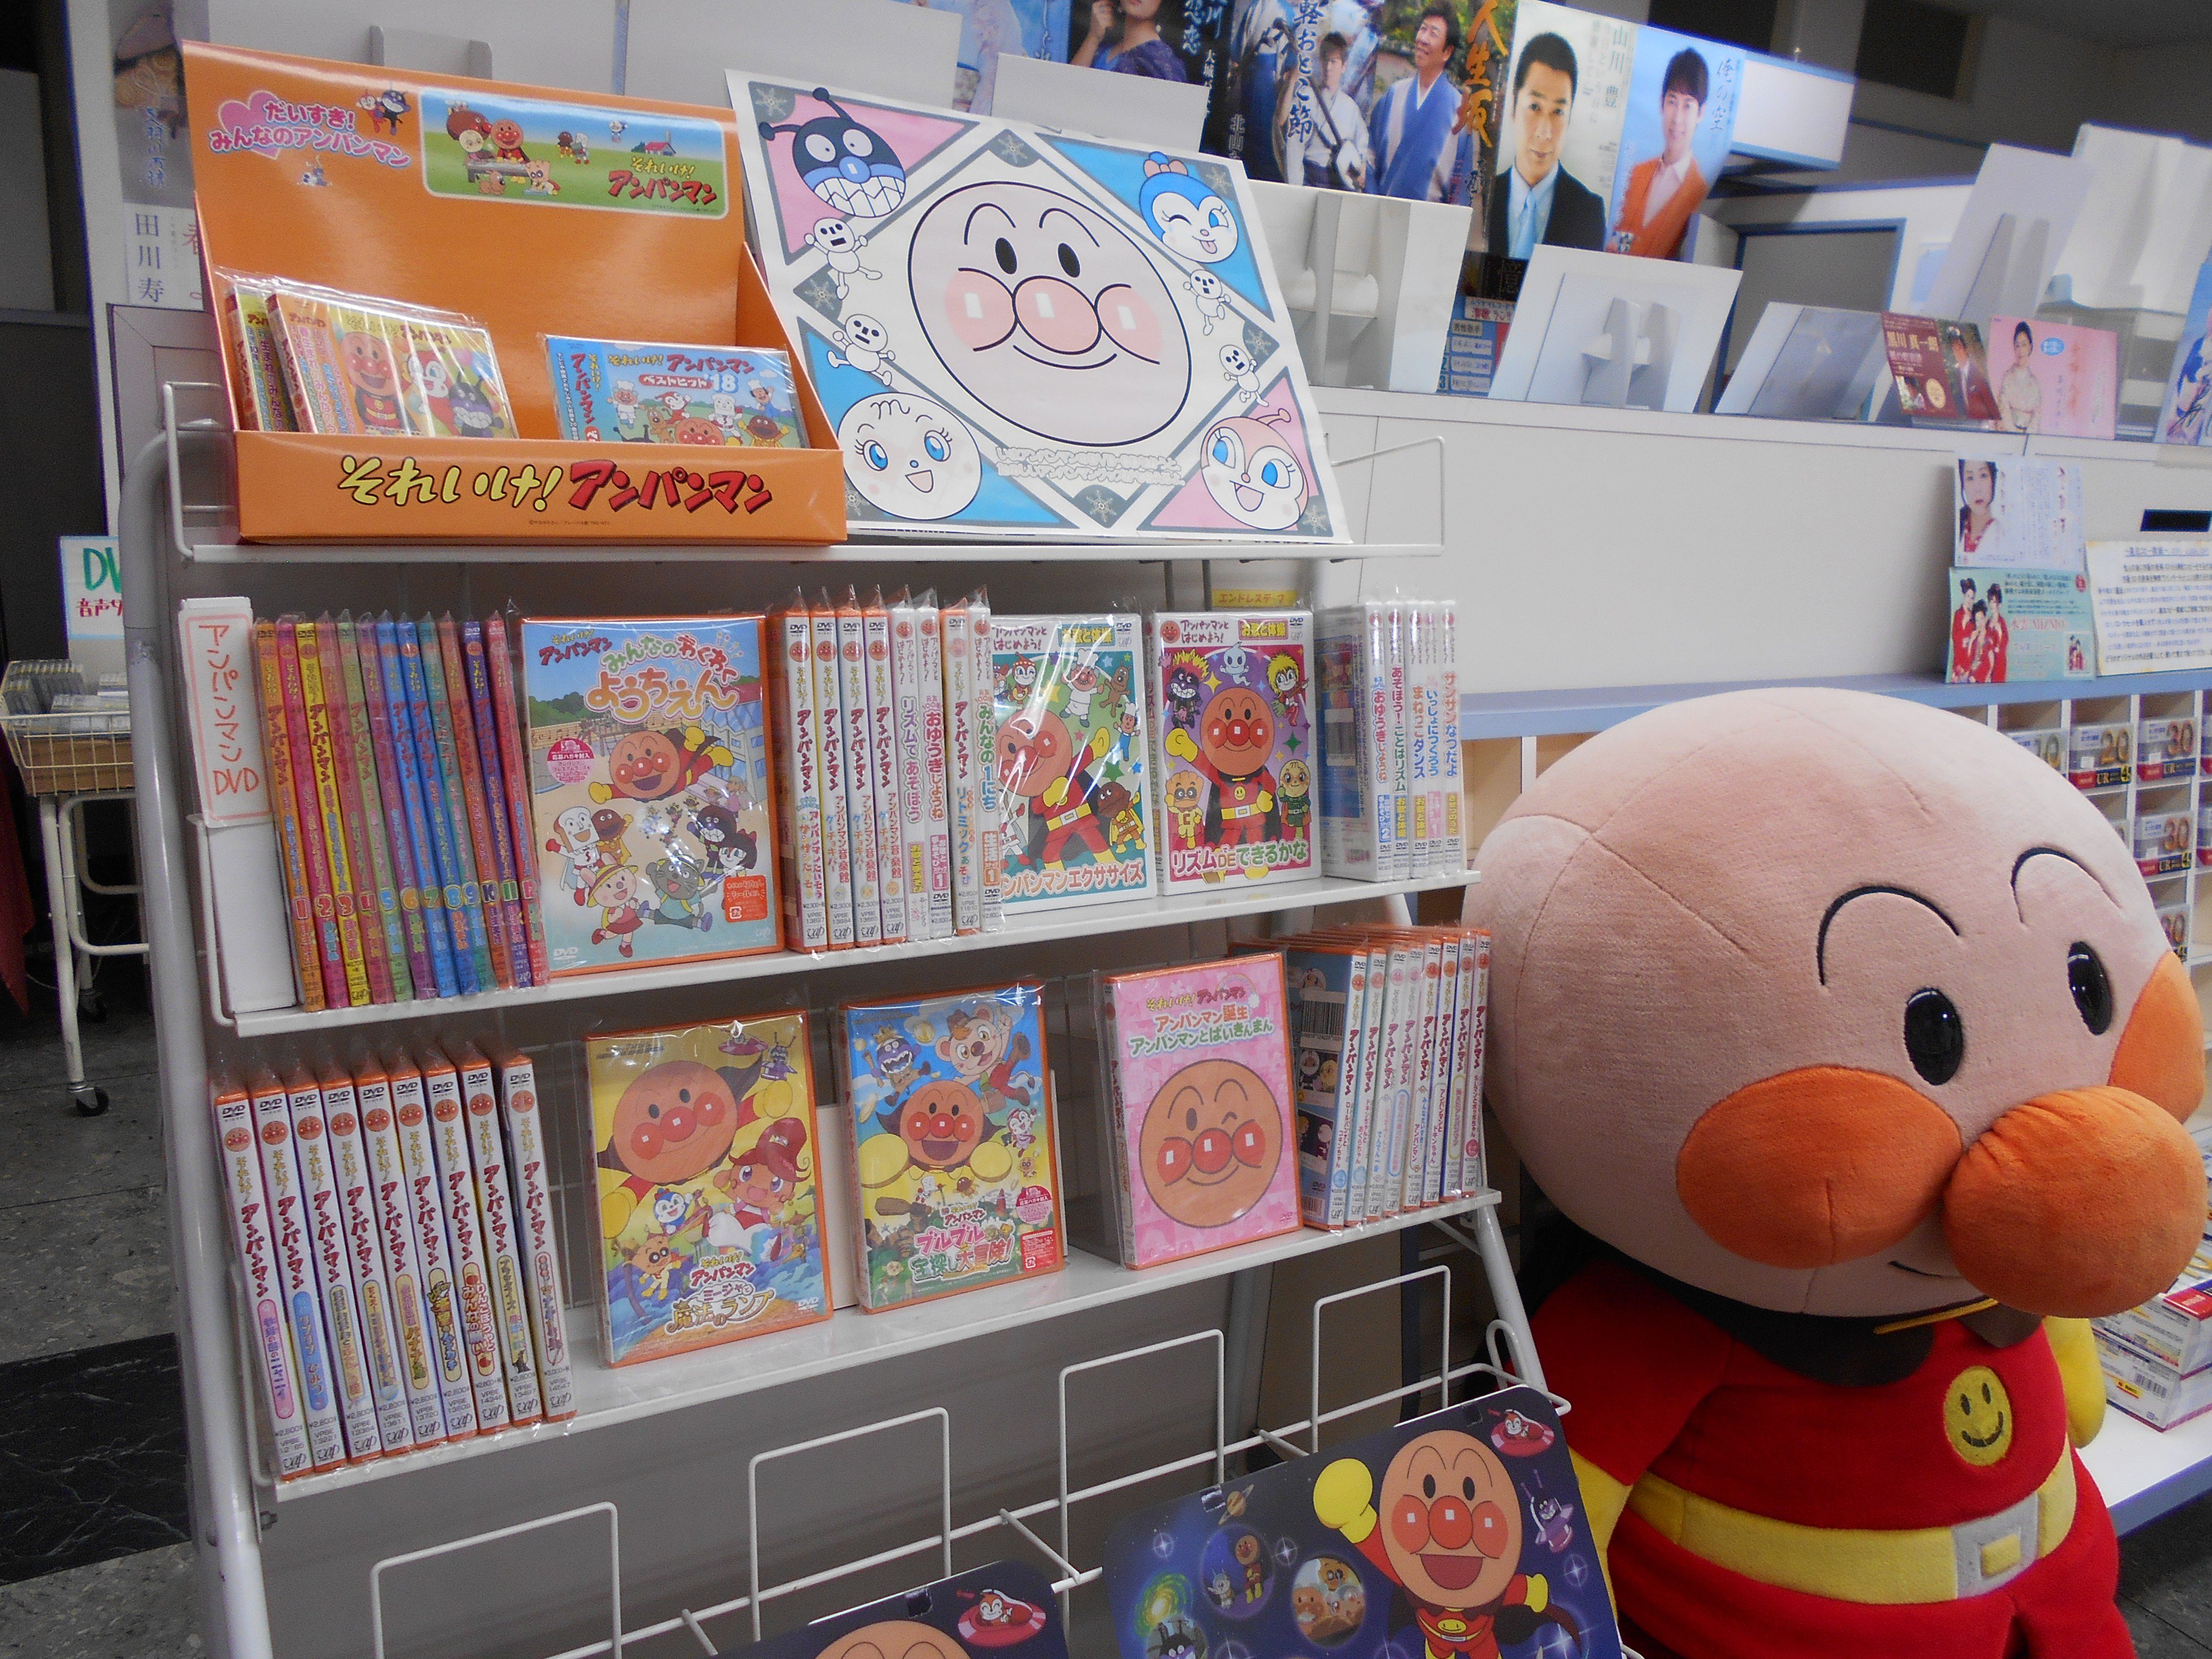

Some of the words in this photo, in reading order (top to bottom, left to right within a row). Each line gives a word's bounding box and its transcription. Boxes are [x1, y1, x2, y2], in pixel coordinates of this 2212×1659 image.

[1604, 25, 1628, 108] 山川豊
[263, 99, 355, 131] だいすき!
[210, 125, 412, 167] みんなのアンパンマン
[631, 156, 696, 179] それいけ!
[608, 170, 717, 205] アンパンマン
[608, 354, 663, 367] それいけ!
[666, 354, 755, 374] アンパンマン
[643, 374, 708, 388] ベストヒット
[570, 353, 596, 424] アンパンマン
[338, 455, 564, 512] それいけ!
[569, 459, 774, 514] アンパンマン
[1181, 620, 1229, 630] アンパンマンと
[1181, 632, 1223, 643] はじめよう!
[539, 637, 613, 666] アンパンマン
[994, 639, 1042, 650] はじめよう!
[198, 624, 243, 763] アンパンマン
[586, 666, 740, 724] ようちえん
[310, 704, 331, 783] アンパンマン
[797, 710, 813, 792] アンパンマン
[824, 709, 839, 791] アンパンマン
[851, 709, 866, 790] アンパンマン
[876, 707, 892, 788] アンパンマン
[955, 702, 970, 779] アンパンマン
[2100, 729, 2130, 765] 20
[2167, 720, 2194, 756] 30
[977, 704, 998, 812] みんなの1にち
[212, 767, 261, 795] DVD
[1381, 828, 1390, 841] 2
[2163, 817, 2191, 851] 30
[989, 869, 994, 881] 1
[1173, 839, 1307, 877] リズムDEできるかな
[446, 887, 463, 908] 8
[464, 884, 479, 903] 9
[937, 874, 944, 887] 1
[316, 896, 333, 917] 2
[338, 896, 353, 915] 3
[381, 888, 395, 911] 5
[402, 888, 418, 909] 6
[1146, 993, 1197, 1011] それいけ!
[1196, 986, 1246, 1004] アンパンマン
[1155, 1003, 1249, 1033] アンパンマン誕生
[1130, 1019, 1273, 1055] アンパンマンとばいきんまん
[1401, 1020, 1415, 1084] アンパンマン
[1420, 1016, 1434, 1081] アンパンマン
[1438, 1013, 1451, 1077] アンパンマン
[1457, 1008, 1469, 1072] アンパンマン
[1474, 1006, 1486, 1069] アンパンマン
[1346, 1029, 1360, 1095] アンパンマン
[1365, 1027, 1379, 1092] アンパンマン
[1384, 1023, 1399, 1089] アンパンマン
[363, 1087, 385, 1097] DVD
[397, 1082, 418, 1091] DVD
[433, 1081, 453, 1091] DVD
[468, 1072, 488, 1082] DVD
[510, 1073, 530, 1082] DVD
[223, 1105, 245, 1115] DVD
[260, 1098, 283, 1108] DVD
[295, 1094, 317, 1104] DVD
[328, 1090, 350, 1101] DVD
[415, 1176, 439, 1266] アンパンマン
[449, 1171, 473, 1260] アンパンマン
[484, 1164, 507, 1253] アンパンマン
[524, 1161, 546, 1250] アンパンマン
[945, 1209, 987, 1225] アンパンマン
[278, 1196, 304, 1290] アンパンマン
[314, 1190, 340, 1283] アンパンマン
[347, 1186, 373, 1278] アンパンマン
[381, 1182, 406, 1272] アンパンマン
[916, 1223, 986, 1256] ブルブル
[241, 1203, 268, 1297] アンパンマン
[692, 1263, 755, 1286] アンパンマン
[703, 1283, 752, 1301] ミージャと
[667, 1290, 775, 1332] 魔法のランプ
